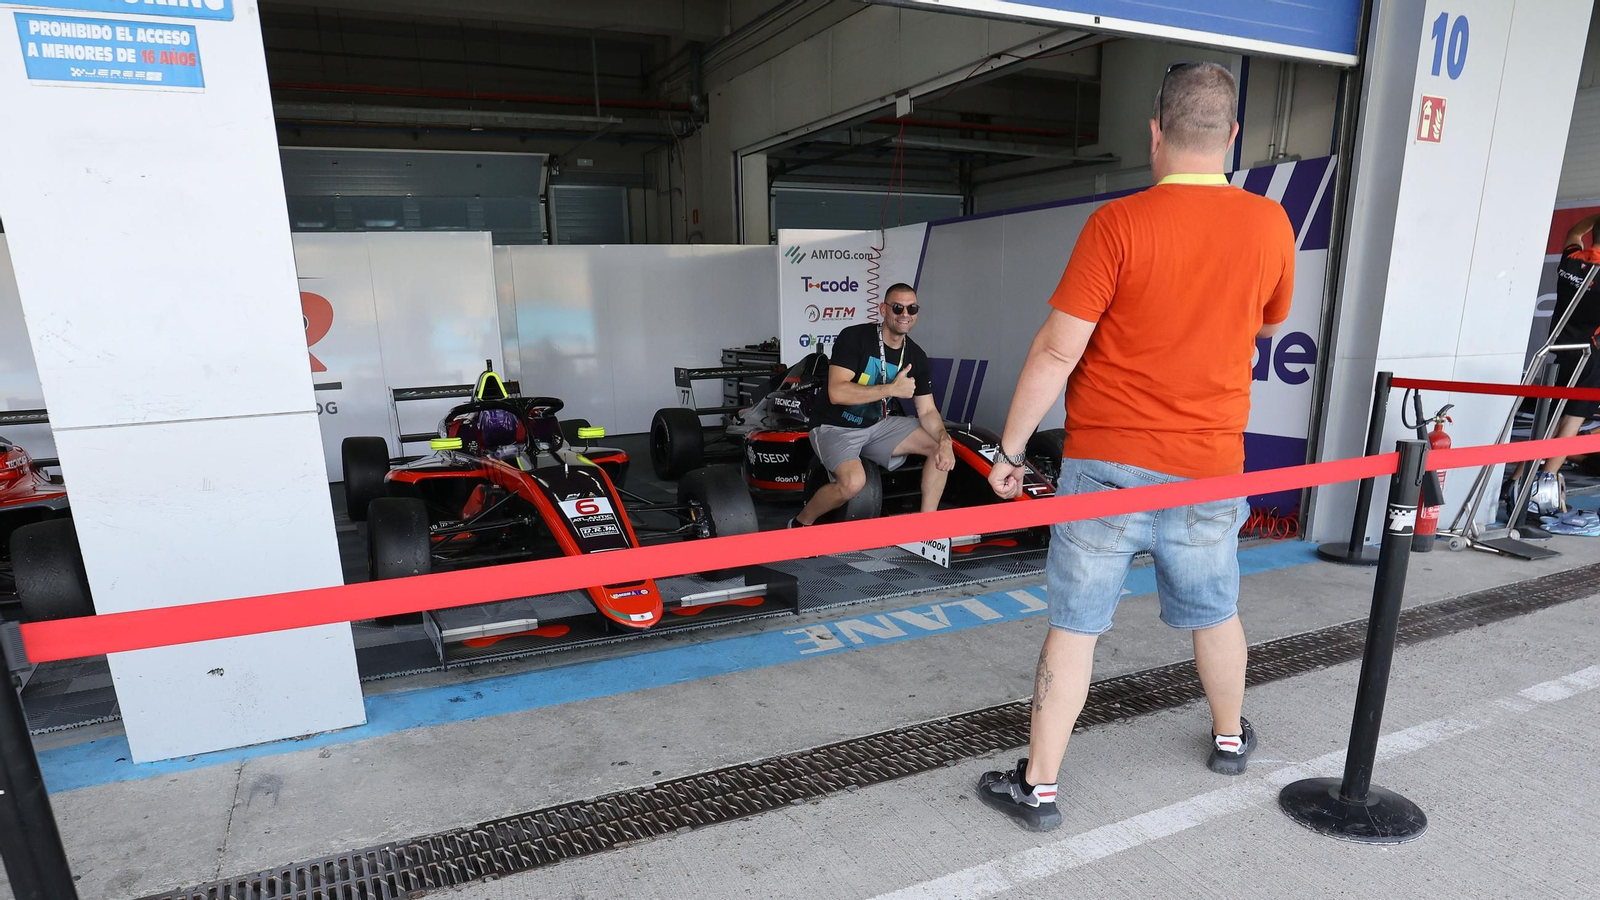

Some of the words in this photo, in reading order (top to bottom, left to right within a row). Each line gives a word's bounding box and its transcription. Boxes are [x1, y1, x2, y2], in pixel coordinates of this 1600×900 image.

[29, 19, 113, 40] PROHIBIDO
[116, 26, 133, 42] EL
[136, 28, 191, 46] ACCESO
[27, 42, 39, 57] A
[42, 43, 113, 62] MENORES
[116, 48, 137, 63] DE
[141, 49, 156, 64] 16
[159, 47, 197, 66] AÑOS
[1431, 11, 1469, 80] 10
[85, 68, 146, 78] JEREZ
[811, 250, 873, 260] AMTOG.com
[681, 389, 690, 405] 77
[575, 498, 600, 515] 6
[783, 598, 1004, 655] LANE
